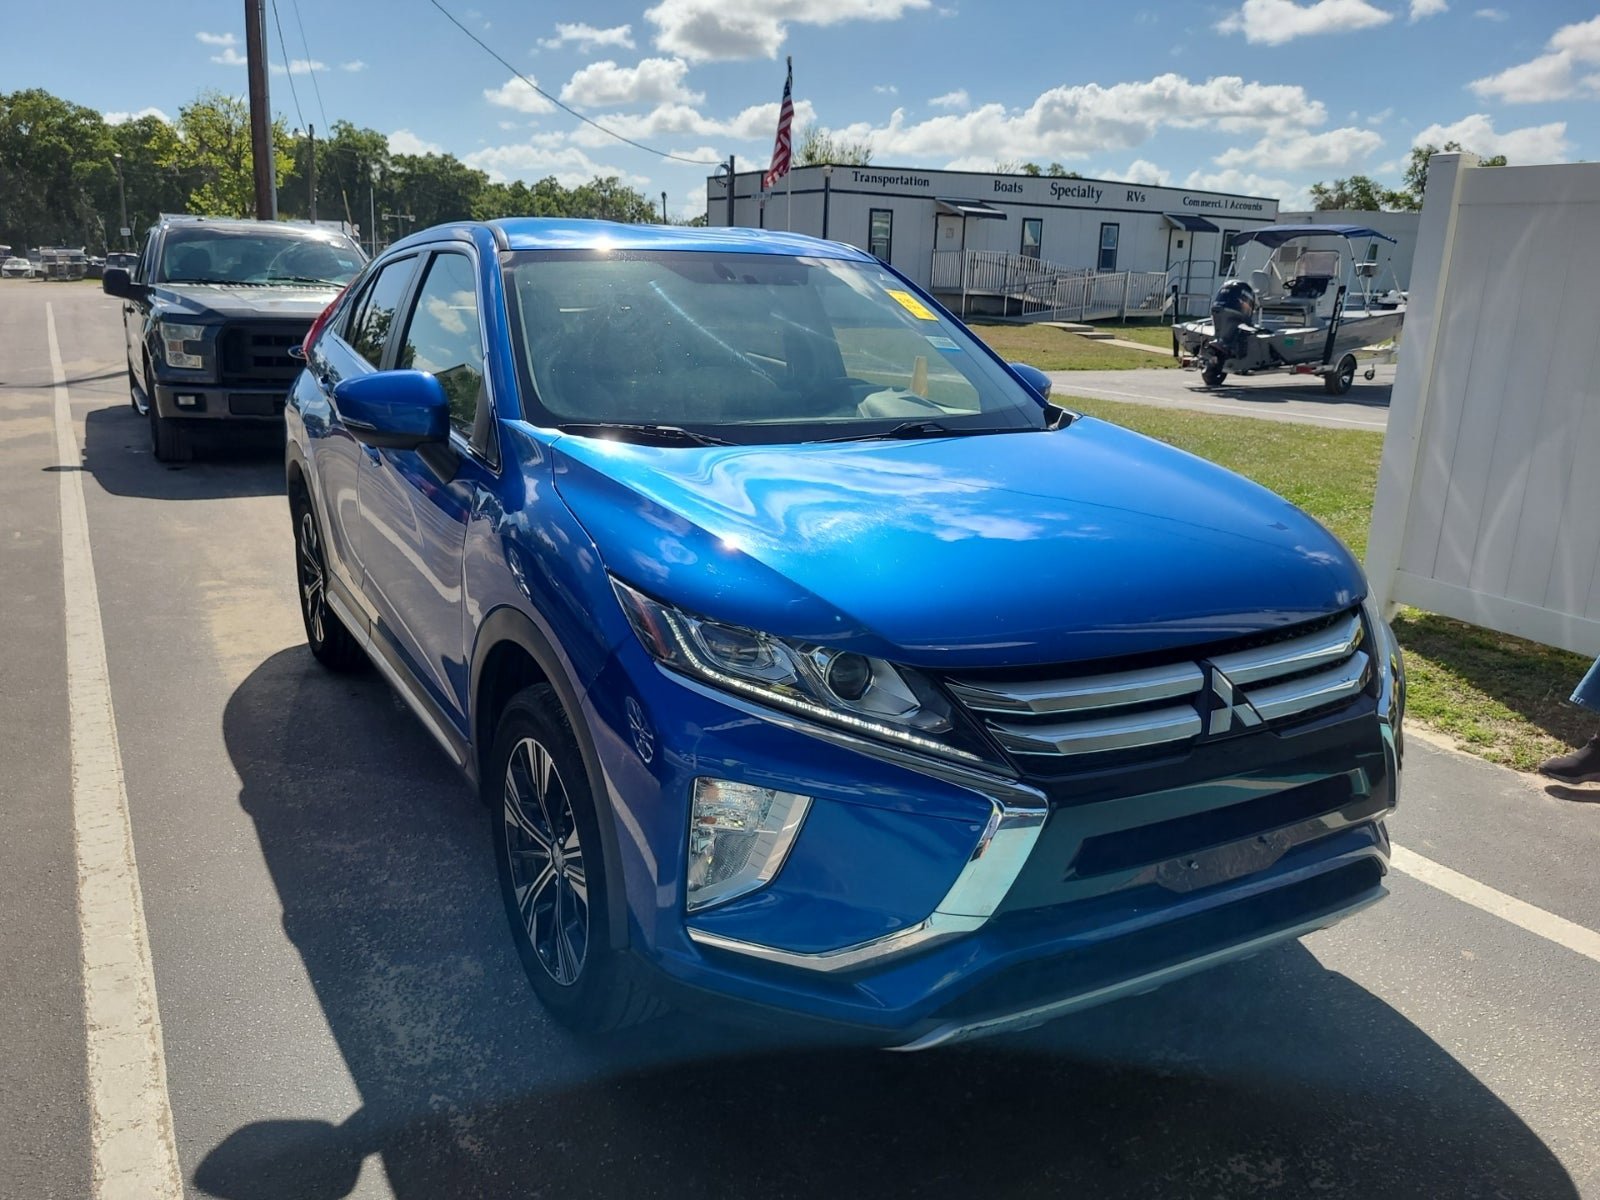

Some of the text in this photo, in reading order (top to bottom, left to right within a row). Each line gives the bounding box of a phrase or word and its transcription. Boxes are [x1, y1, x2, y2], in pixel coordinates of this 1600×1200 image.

[852, 171, 930, 188] Transportation
[994, 180, 1023, 193] Boats
[1050, 182, 1103, 203] Specialty
[1126, 190, 1146, 203] RVs
[1183, 196, 1263, 211] Commercil Accounts
